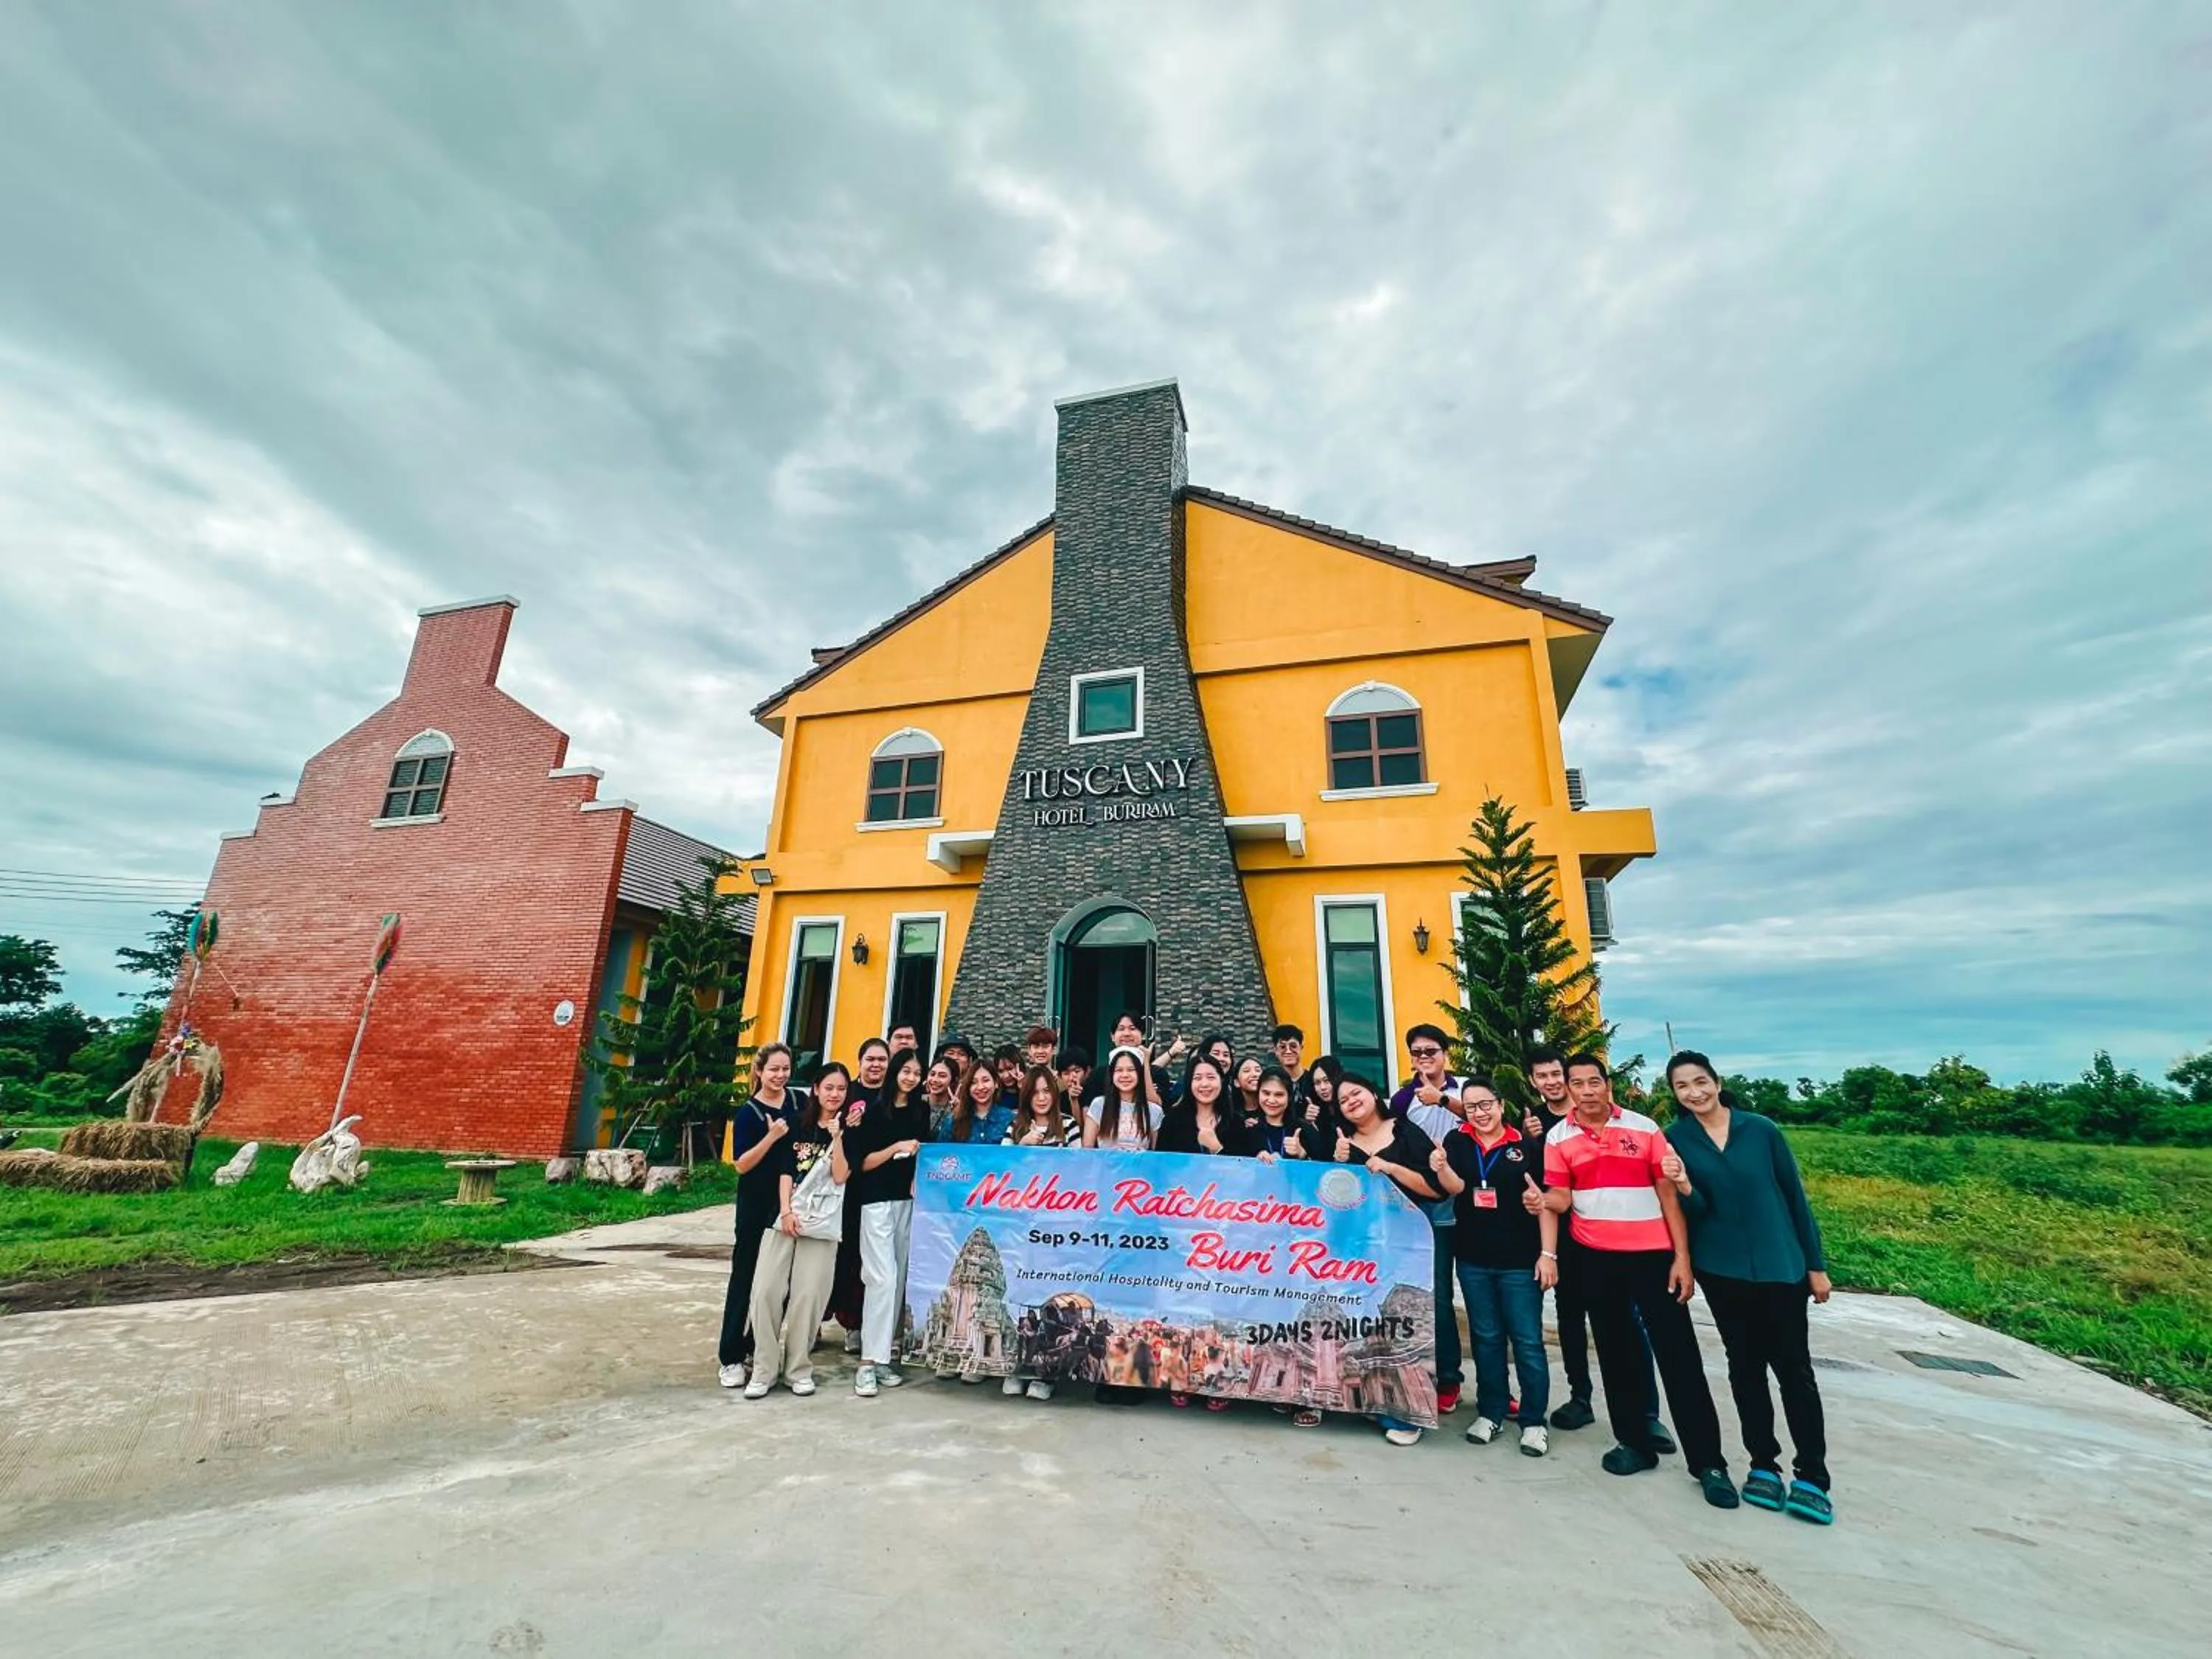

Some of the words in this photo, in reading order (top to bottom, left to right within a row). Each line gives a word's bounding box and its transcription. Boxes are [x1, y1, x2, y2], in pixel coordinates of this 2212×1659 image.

[1018, 757, 1193, 799] TUSCANY
[1033, 807, 1095, 826] HOTEL
[1104, 801, 1176, 821] BURIRAM
[966, 1171, 1098, 1211] Nakhon
[1113, 1179, 1325, 1228] Ratchasima
[1029, 1229, 1064, 1247] Sep
[1070, 1233, 1114, 1248] 9-11,
[1119, 1235, 1169, 1251] 2023
[1186, 1231, 1276, 1275] Buri
[1288, 1240, 1377, 1284] Ram
[1017, 1268, 1105, 1283] International
[1108, 1273, 1183, 1291] Hospitality
[1186, 1280, 1210, 1292] and
[1214, 1282, 1270, 1297] Tourism
[1273, 1288, 1363, 1305] Management
[1246, 1318, 1312, 1345] 3DAYS
[1321, 1316, 1415, 1341] 2NIGHTS
